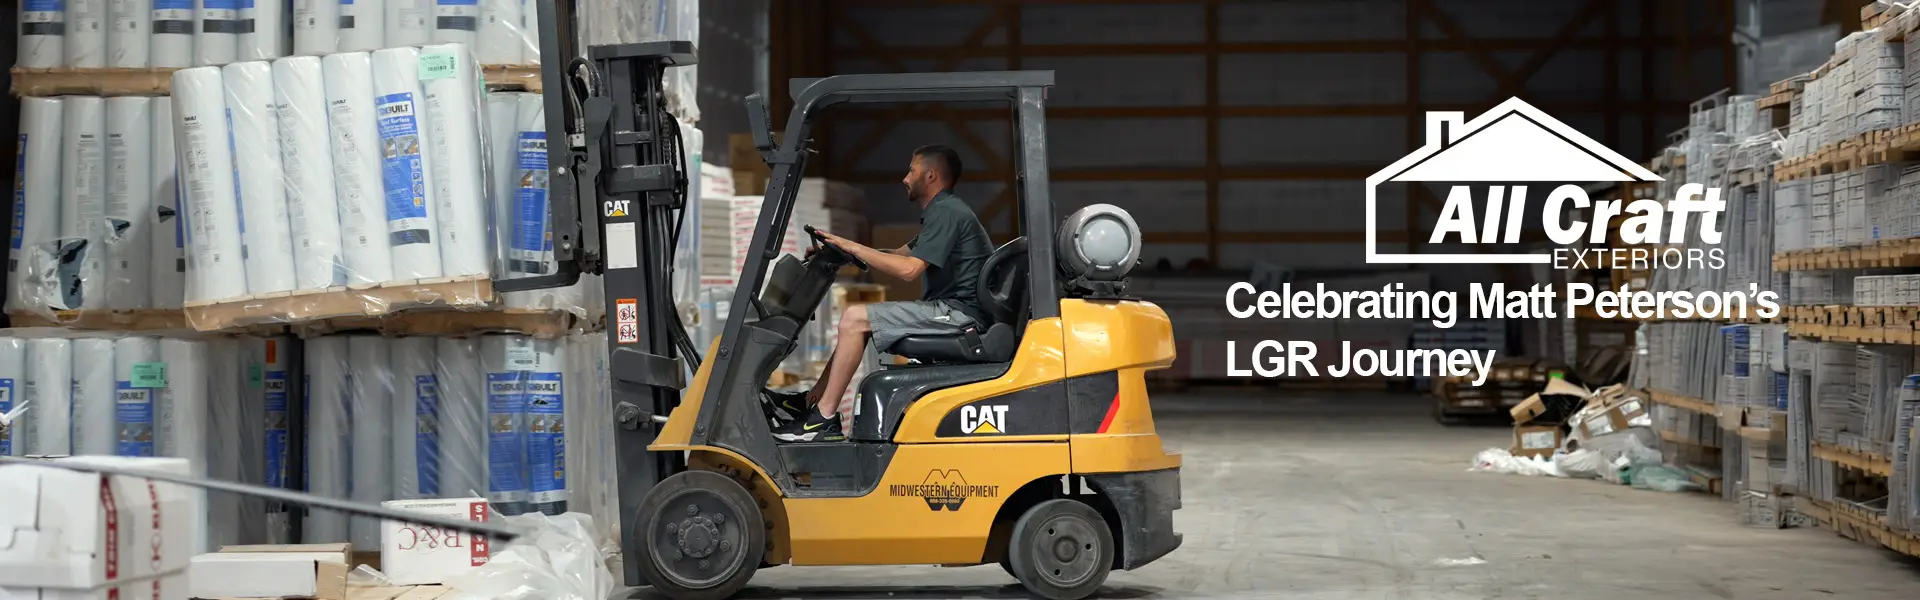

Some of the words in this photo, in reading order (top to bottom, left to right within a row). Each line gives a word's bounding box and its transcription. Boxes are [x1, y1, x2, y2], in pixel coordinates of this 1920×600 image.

[603, 199, 631, 217] CAT
[960, 404, 1009, 434] CAT
[889, 484, 947, 497] MIDWESTERN
[950, 485, 999, 498] EQUIPMENT
